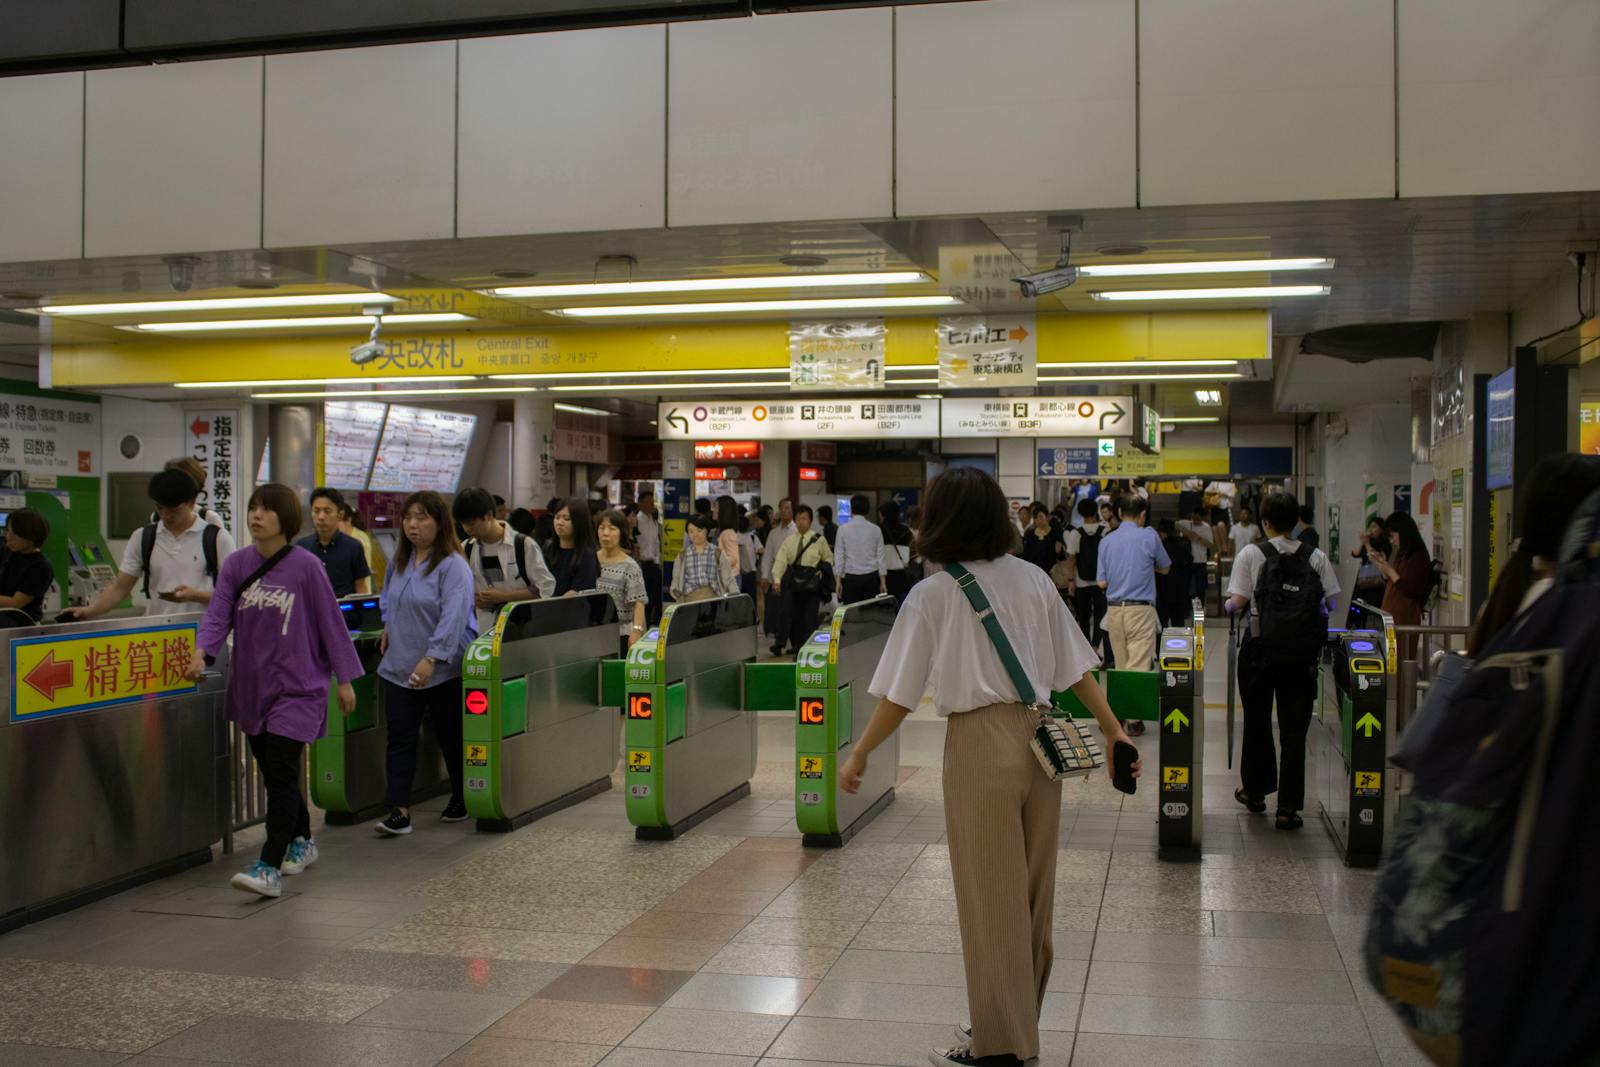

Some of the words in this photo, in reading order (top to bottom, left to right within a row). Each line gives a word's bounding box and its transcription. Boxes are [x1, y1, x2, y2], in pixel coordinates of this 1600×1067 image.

[476, 337, 521, 351] Central
[525, 335, 549, 349] Exit
[709, 422, 732, 431] (B2F)
[817, 421, 835, 430] (2F)
[877, 421, 901, 430] (B2F)
[1018, 419, 1042, 429] (B3F)
[24, 438, 56, 457] 回数券
[213, 415, 232, 532] 指定席券売
[466, 645, 492, 661] IC
[629, 648, 655, 665] IC
[799, 651, 827, 669] IC
[84, 635, 194, 699] 精算機
[467, 664, 487, 677] 専用
[630, 668, 650, 681] 専用
[799, 672, 822, 685] 専用
[630, 695, 652, 718] IC
[801, 700, 824, 723] IC
[469, 779, 475, 788] 5
[478, 779, 484, 788] 6
[632, 786, 638, 795] 6
[642, 786, 648, 795] 7
[803, 793, 808, 801] 7
[813, 793, 819, 801] 8
[1167, 805, 1173, 814] 9
[1178, 805, 1186, 814] 10
[1363, 810, 1372, 819] 10
